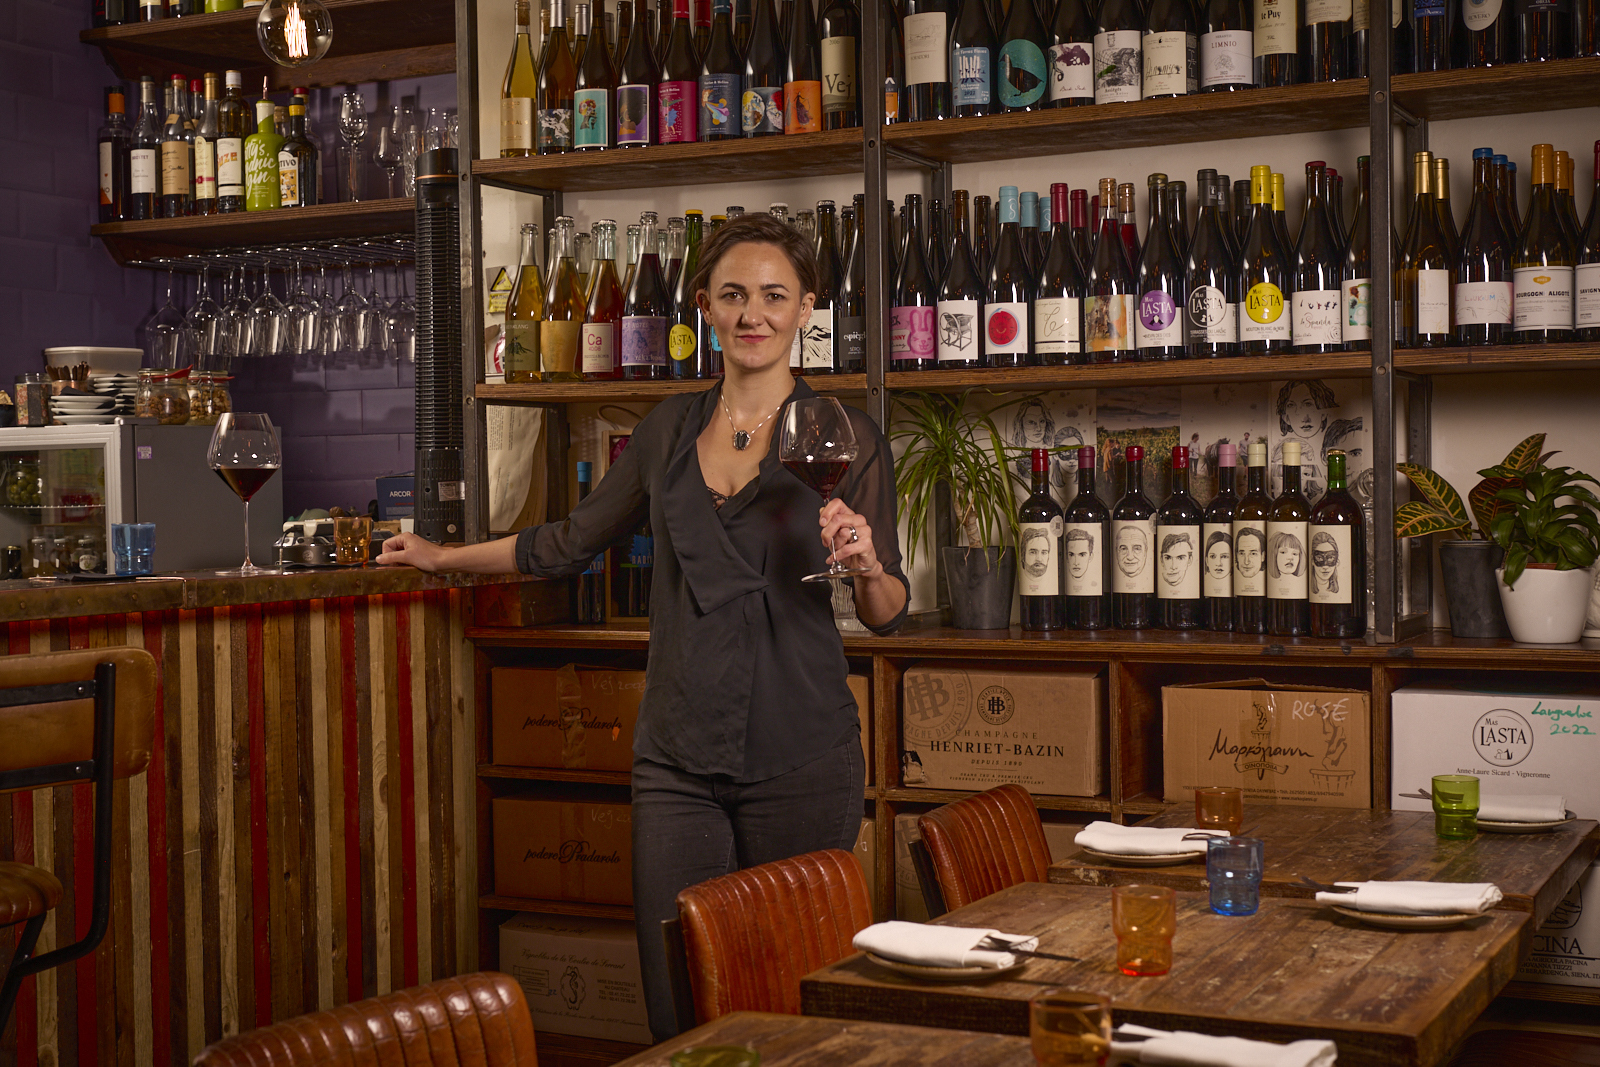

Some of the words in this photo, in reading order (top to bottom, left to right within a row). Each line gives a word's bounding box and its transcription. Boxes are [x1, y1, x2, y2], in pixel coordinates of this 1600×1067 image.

[1268, 10, 1281, 19] Puy
[825, 73, 852, 100] Vej
[1192, 298, 1223, 313] LASTA
[1250, 294, 1281, 309] LASTA
[1142, 302, 1172, 317] LASTA
[588, 333, 602, 346] Ca
[671, 334, 692, 348] LASTA
[522, 714, 558, 730] podere
[1550, 724, 1596, 735] 2022
[955, 730, 1038, 739] CHAMPAGNE
[1480, 726, 1527, 746] LASTA
[930, 740, 1064, 757] HENRIET-BAZIN
[1516, 770, 1550, 779] Vigneronne
[523, 847, 558, 862] podere
[559, 840, 621, 864] Pradarolo
